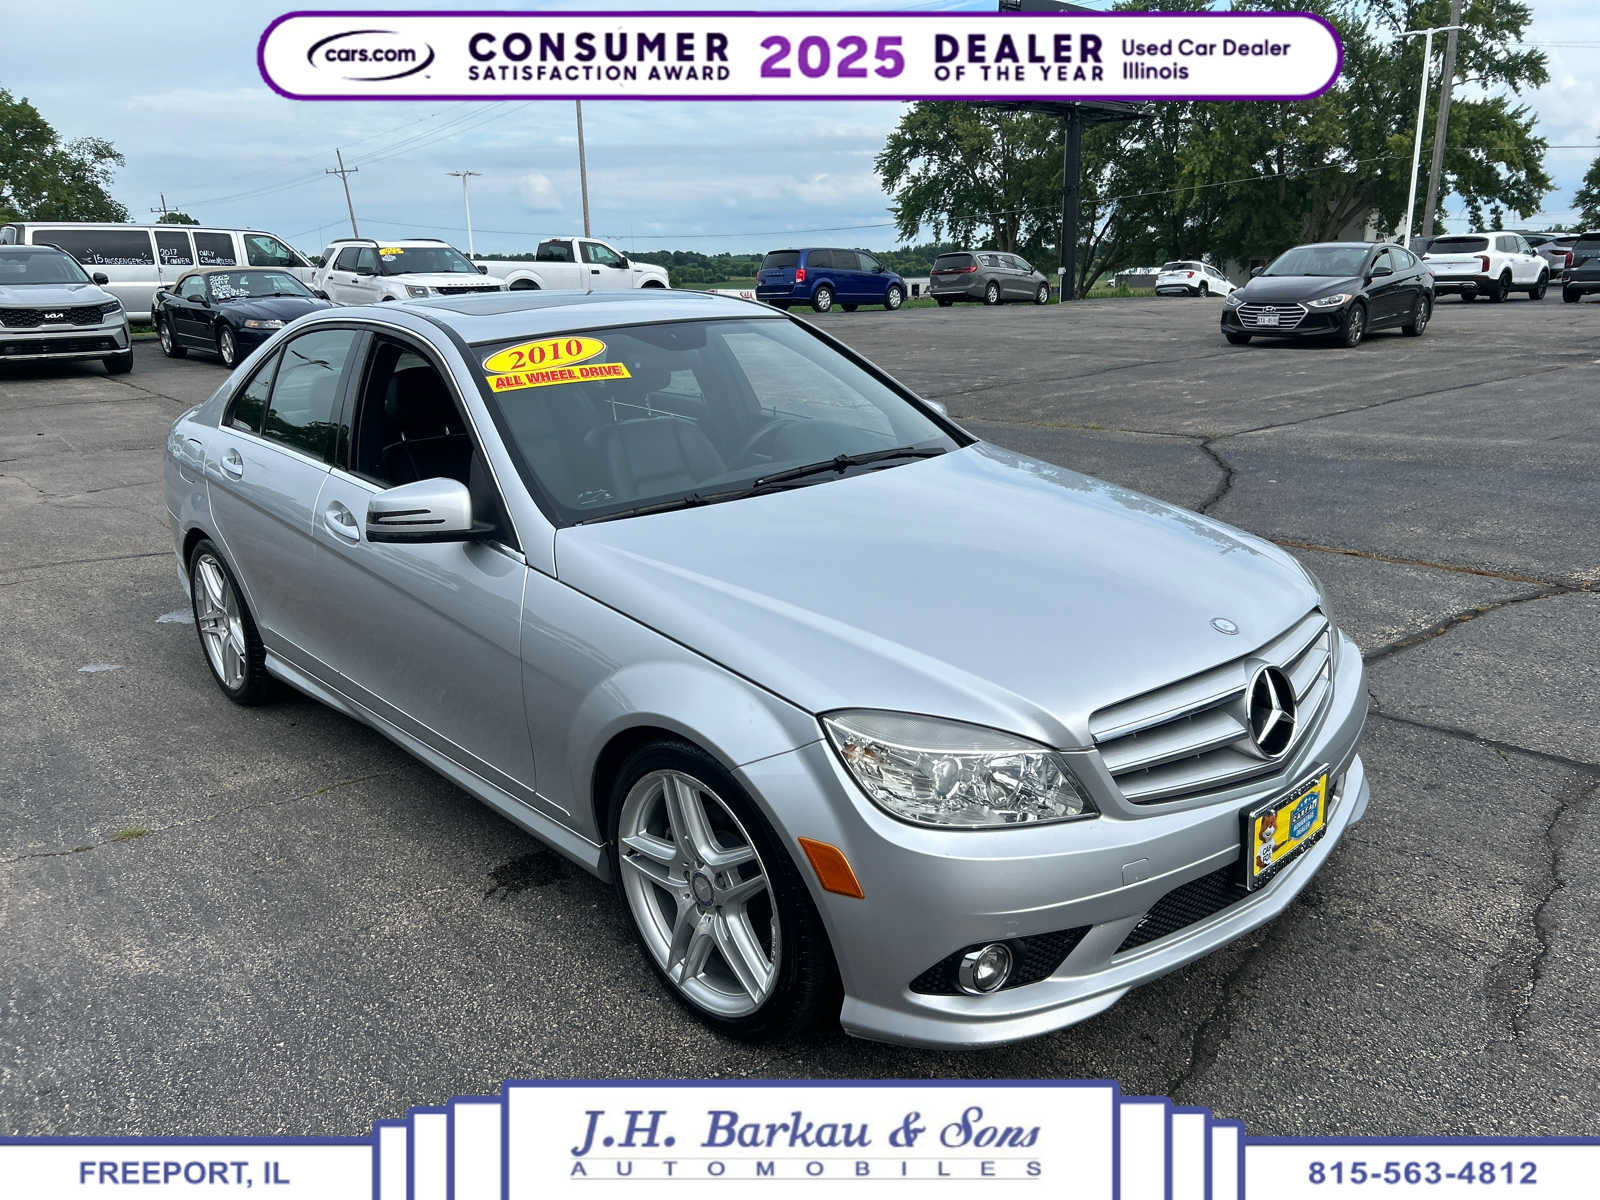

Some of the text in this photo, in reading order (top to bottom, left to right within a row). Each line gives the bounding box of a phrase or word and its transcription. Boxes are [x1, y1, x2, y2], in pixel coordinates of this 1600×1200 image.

[509, 339, 582, 370] 2010
[495, 364, 624, 389] ALL WHEEL DRIVE
